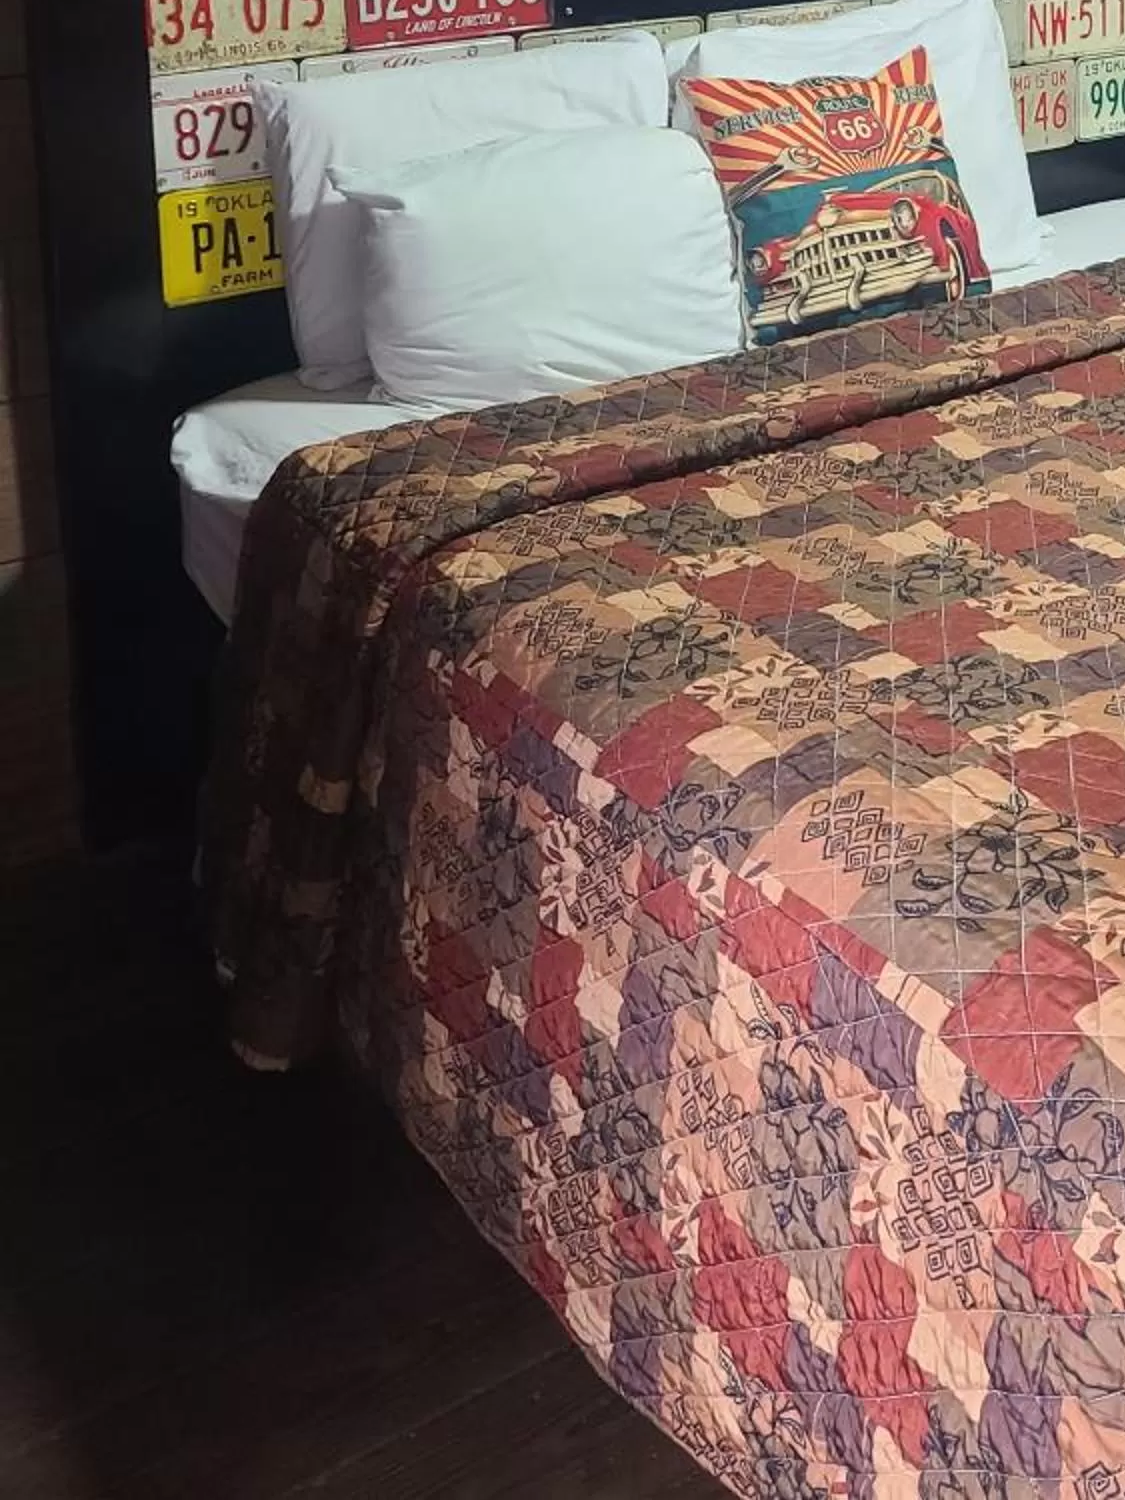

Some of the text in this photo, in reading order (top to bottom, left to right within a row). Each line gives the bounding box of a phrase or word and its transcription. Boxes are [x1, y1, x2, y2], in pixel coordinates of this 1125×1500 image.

[405, 12, 502, 35] LAND OF LINCOLN
[1051, 70, 1067, 87] OK
[1085, 65, 1098, 77] 19
[174, 101, 253, 161] 829
[712, 105, 801, 138] SERVICE
[838, 117, 872, 140] 66
[177, 202, 198, 218] 19
[221, 269, 273, 287] FARM
